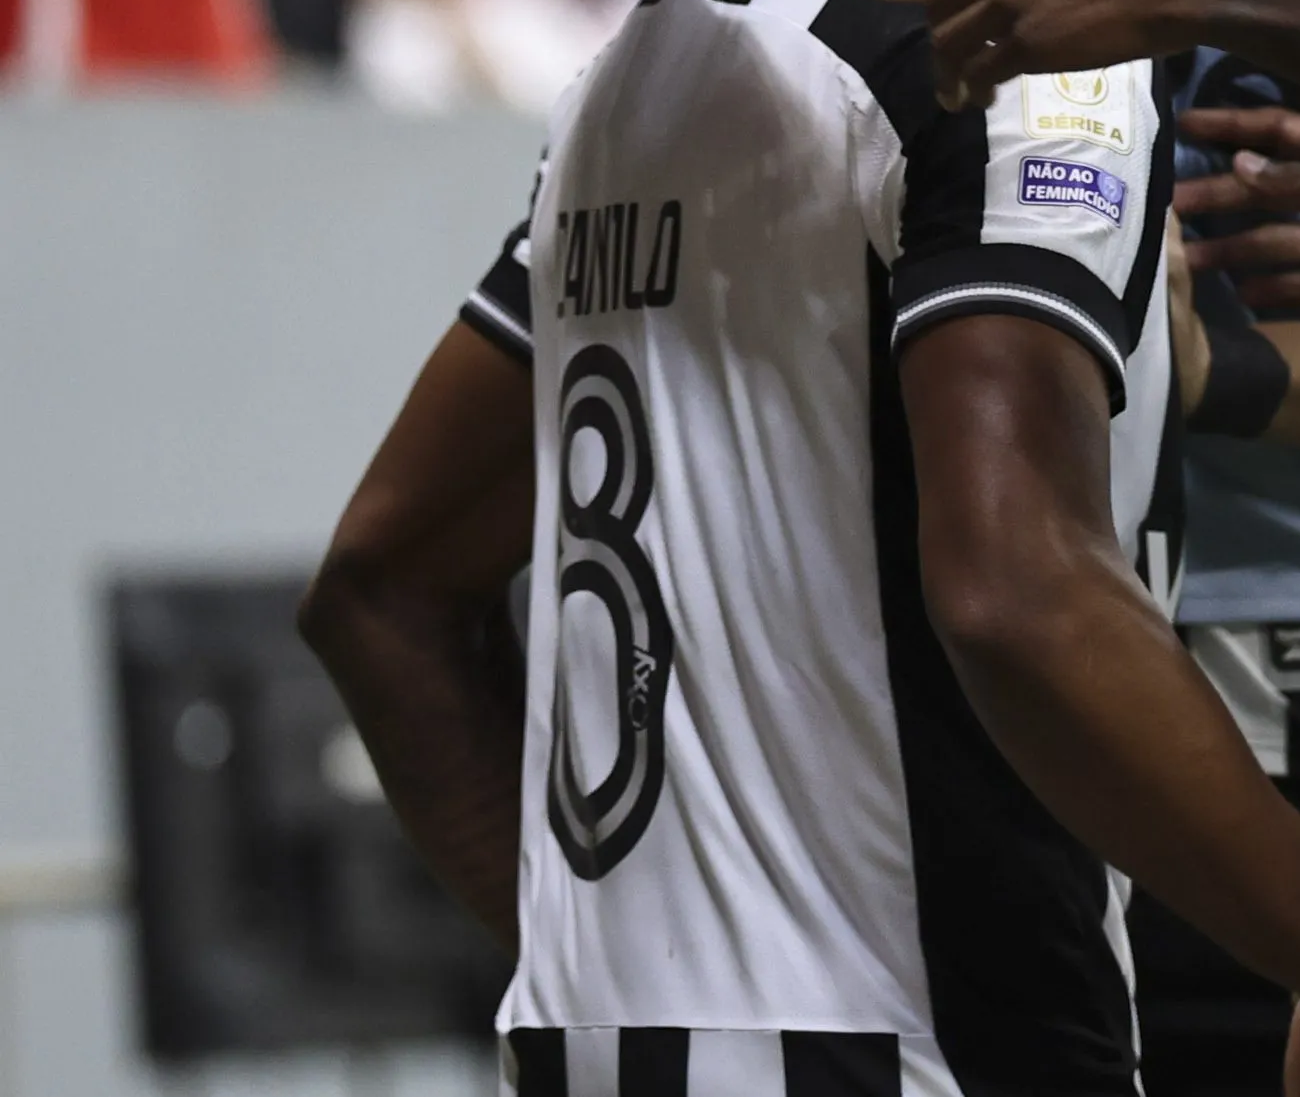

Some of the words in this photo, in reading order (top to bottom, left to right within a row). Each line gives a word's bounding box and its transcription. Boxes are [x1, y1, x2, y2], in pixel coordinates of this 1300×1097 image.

[1037, 113, 1105, 137] SÉRIE
[1110, 128, 1124, 144] A
[1027, 162, 1066, 181] NÃO
[1068, 169, 1094, 184] AO
[1026, 184, 1121, 219] FEMINICÍDIO
[547, 343, 673, 881] 8
